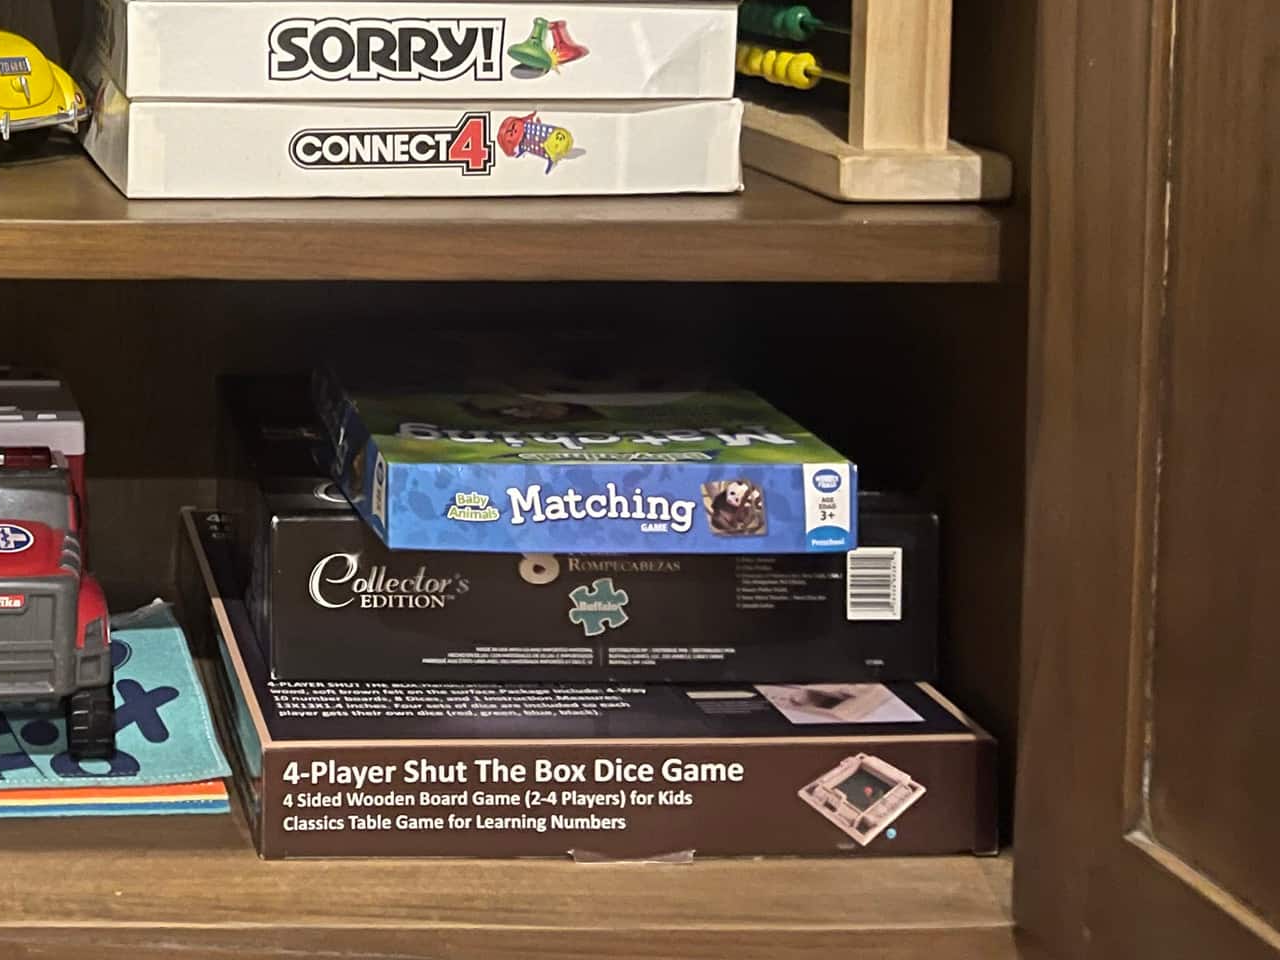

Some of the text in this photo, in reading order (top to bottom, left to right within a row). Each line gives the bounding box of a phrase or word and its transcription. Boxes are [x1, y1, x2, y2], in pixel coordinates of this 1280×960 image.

[272, 19, 502, 80] SORRY!
[293, 119, 489, 170] CONNECT 4
[456, 491, 490, 508] Baby
[506, 482, 696, 533] Matching
[447, 505, 499, 522] Animals
[819, 510, 836, 522] 3+
[640, 522, 669, 533] GAME
[568, 557, 681, 573] ROMPECABEZAS
[309, 552, 470, 608] Collector's
[360, 594, 446, 609] EDITION
[282, 758, 745, 789] 4-Player Shut The Box Dice Game
[282, 790, 694, 809] 4 Sided Wooden Board Game (2-4 Players) for Kids
[283, 813, 627, 833] Classics Table Game for Learning Numbers
